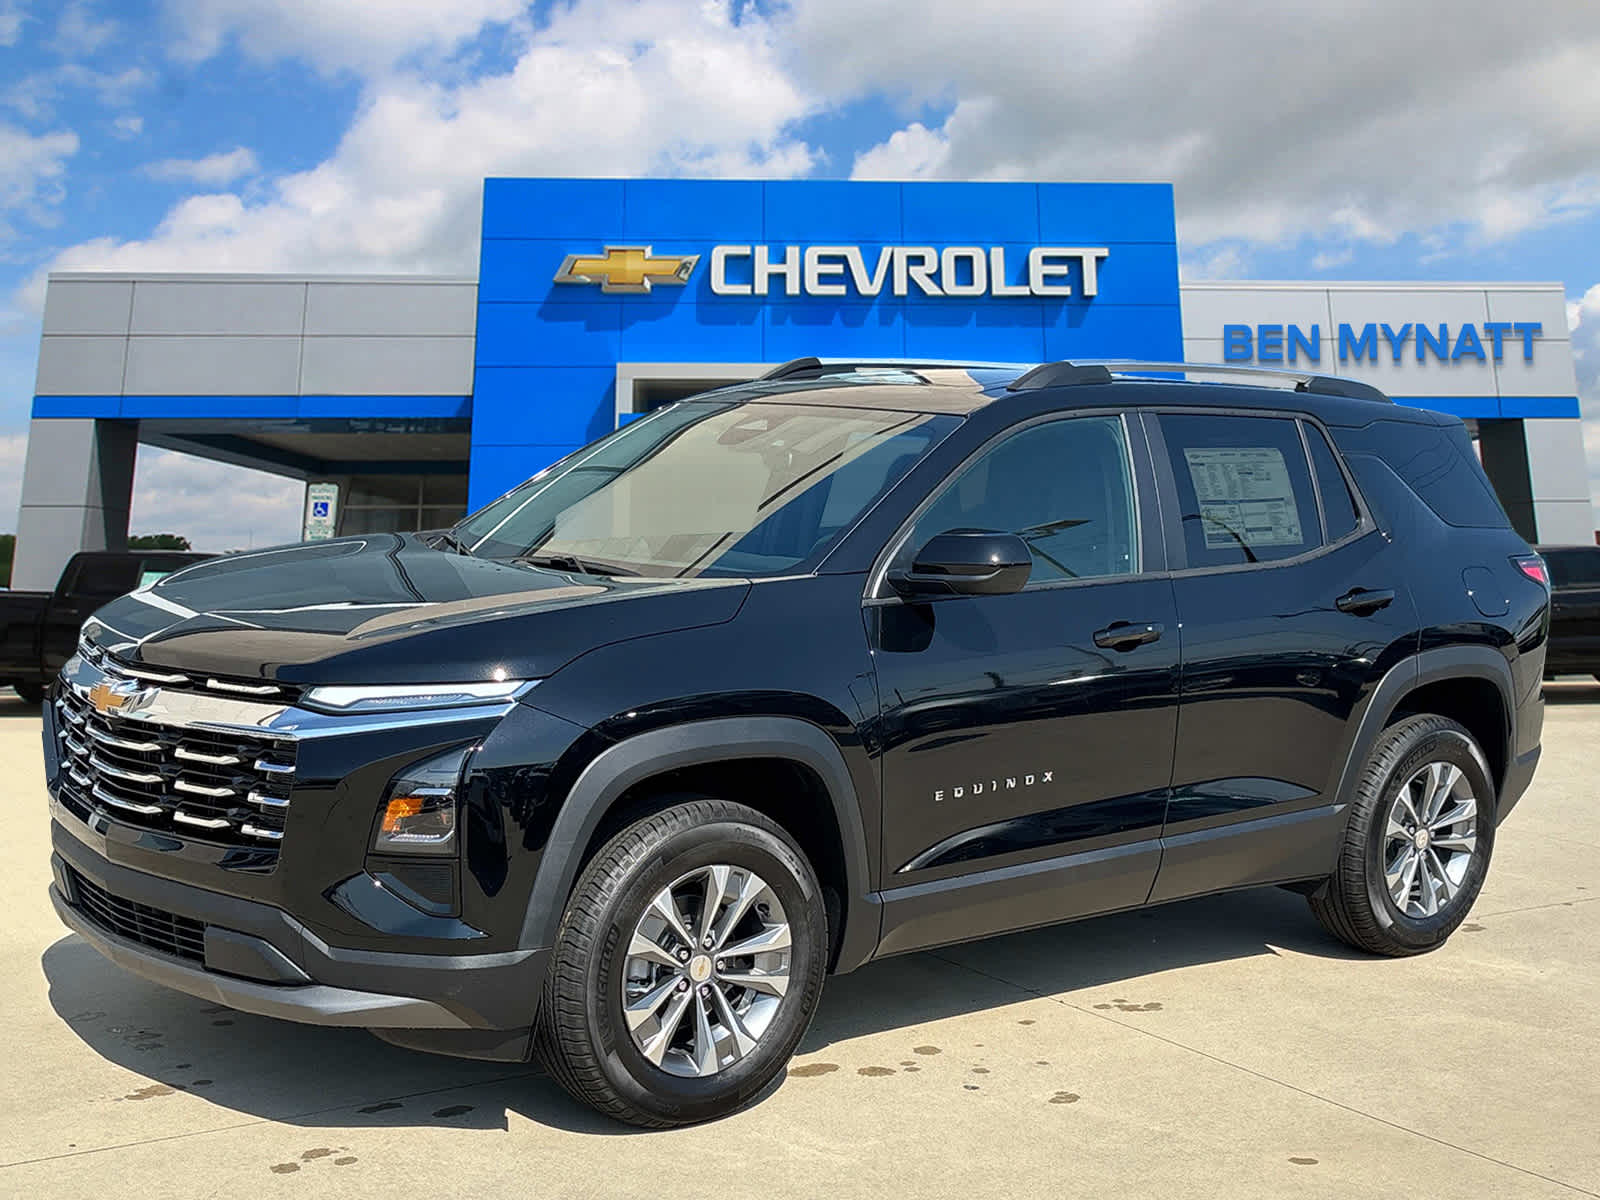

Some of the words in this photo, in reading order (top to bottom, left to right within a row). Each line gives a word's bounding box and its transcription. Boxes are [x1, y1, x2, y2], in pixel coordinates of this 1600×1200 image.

[711, 245, 1109, 297] CHEVROLET
[1224, 323, 1321, 361] BEN
[1339, 321, 1542, 361] MYNATT
[934, 771, 1054, 802] EQUINOX
